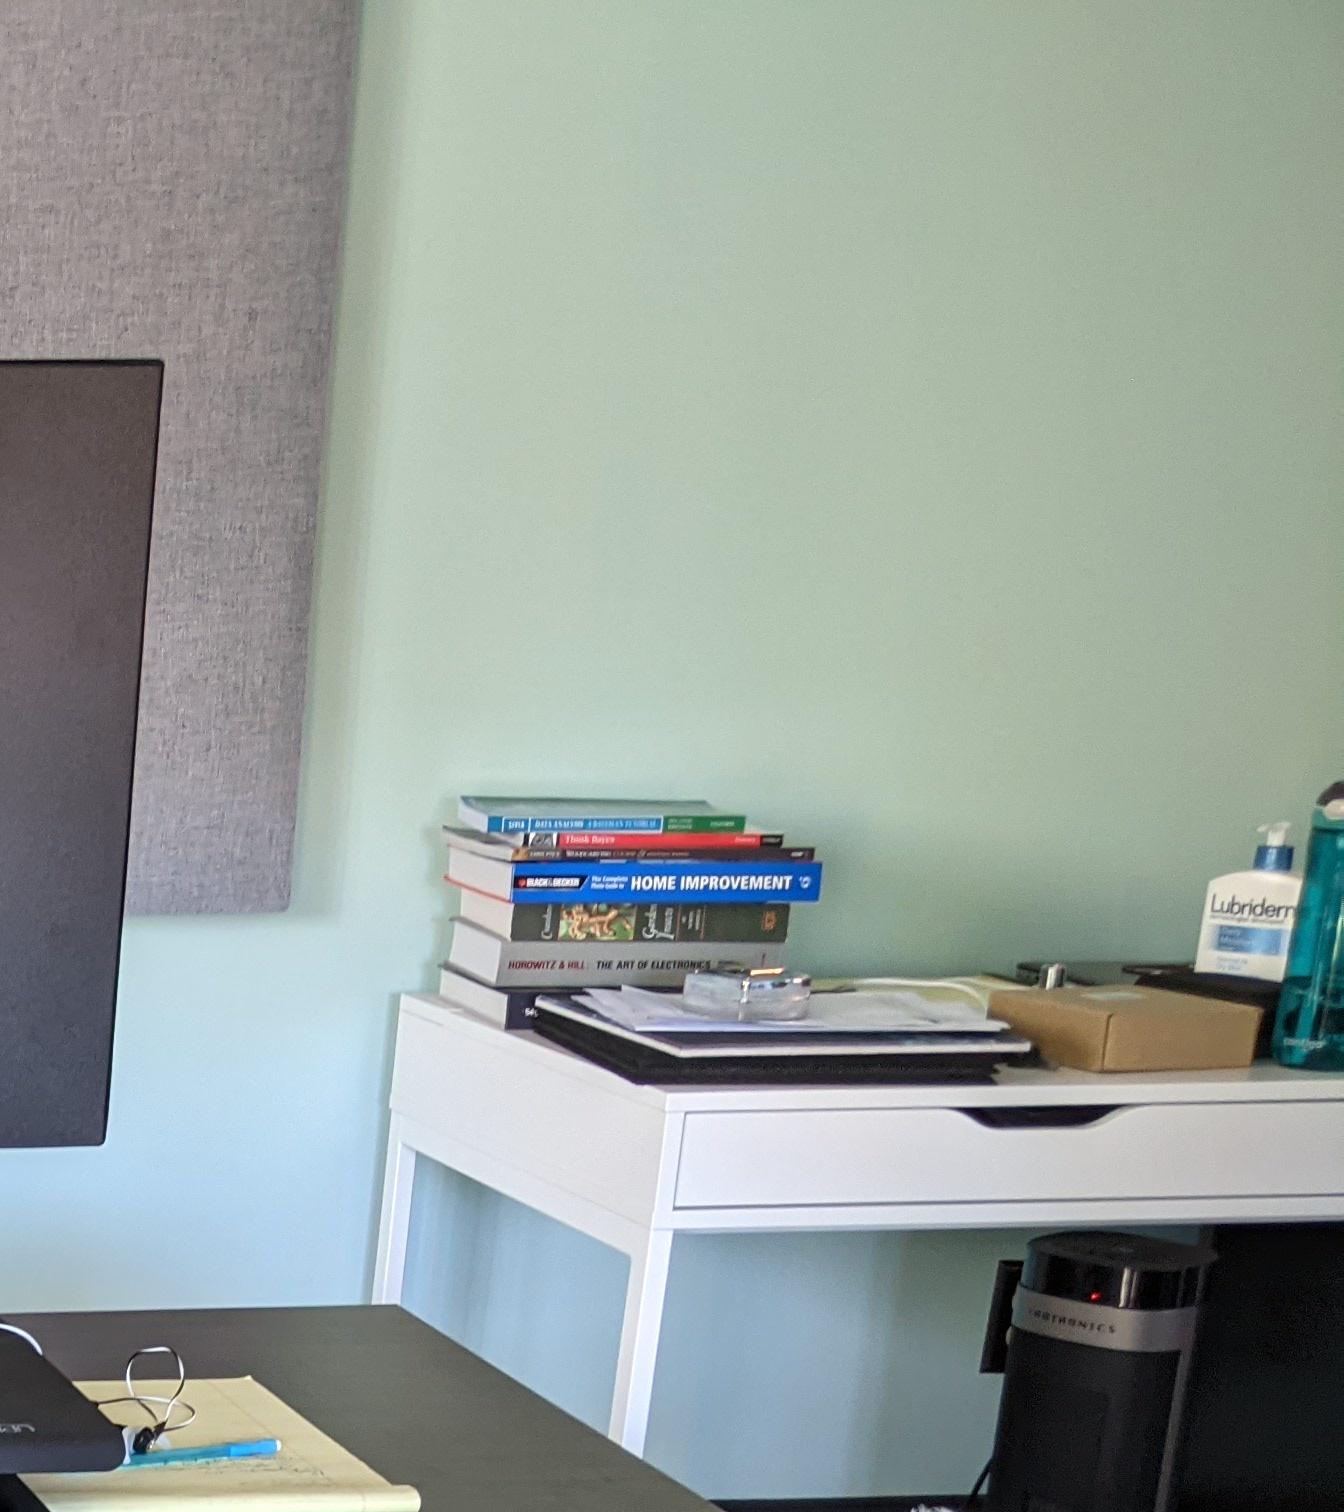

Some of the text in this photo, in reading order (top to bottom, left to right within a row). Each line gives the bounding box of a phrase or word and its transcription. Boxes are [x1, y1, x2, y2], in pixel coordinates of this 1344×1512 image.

[631, 875, 793, 891] HOME IMPROVEMENT
[508, 960, 556, 970] HOROWITZ
[596, 960, 612, 970] THE
[616, 960, 635, 970] ART
[637, 960, 649, 970] OF
